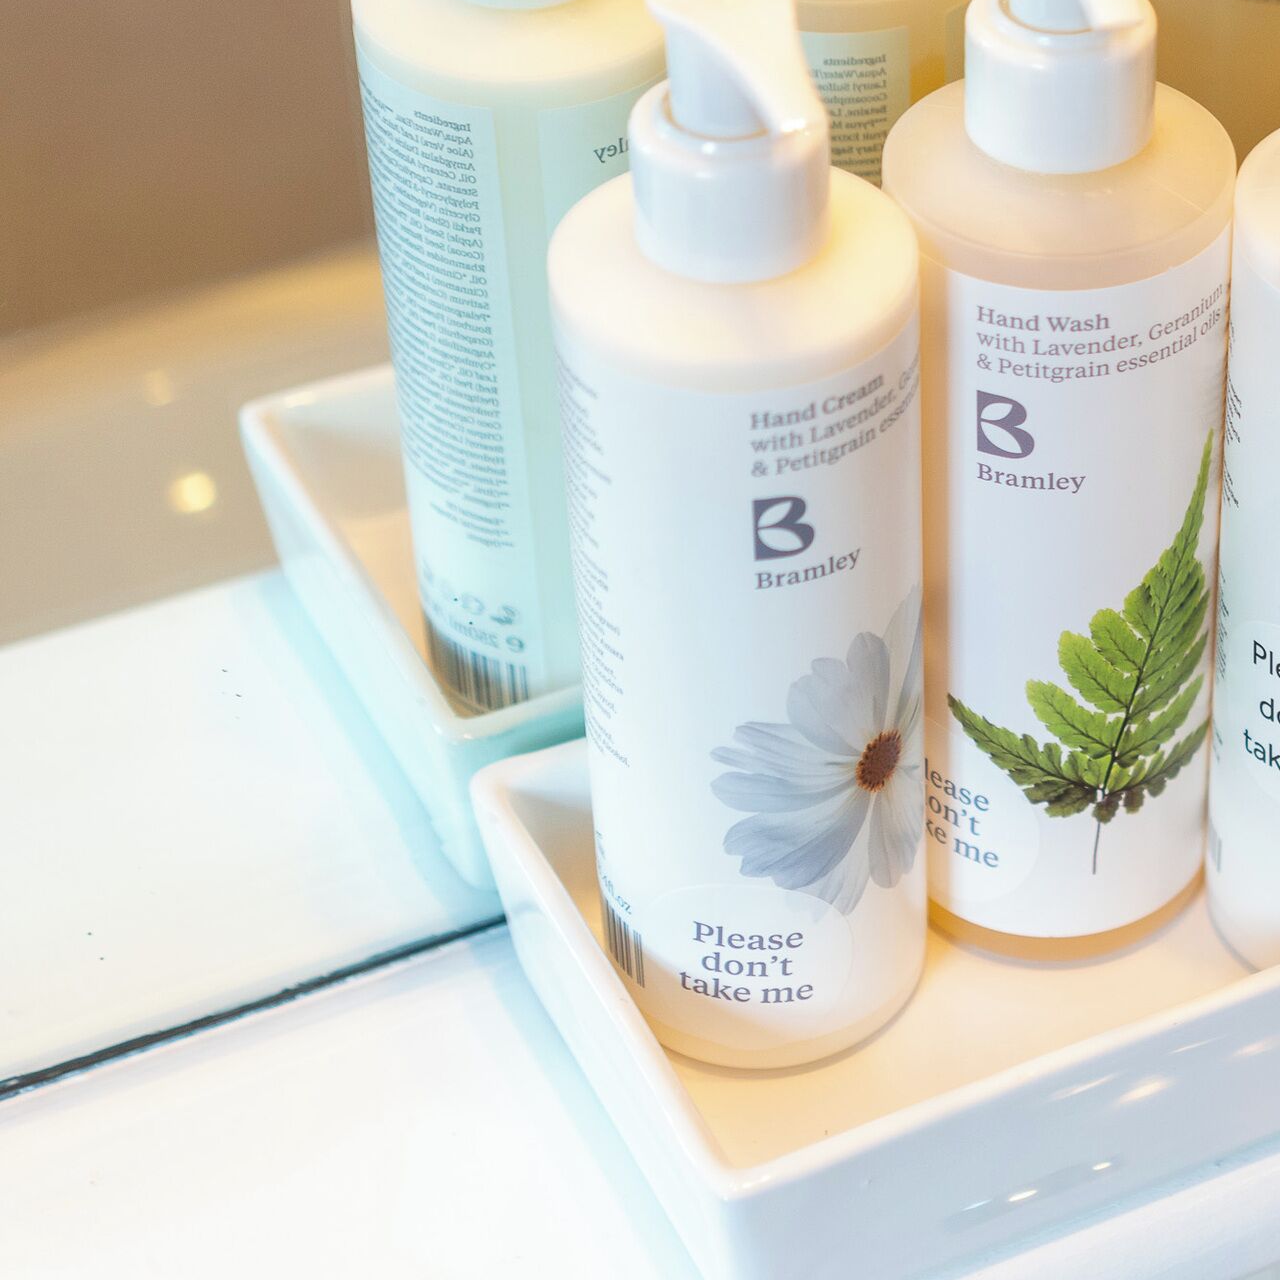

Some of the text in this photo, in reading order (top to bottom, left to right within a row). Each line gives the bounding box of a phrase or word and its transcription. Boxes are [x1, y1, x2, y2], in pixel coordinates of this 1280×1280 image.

[976, 304, 1110, 333] Hand Wash
[976, 282, 1223, 357] with Lavender, Geranium
[976, 306, 1221, 384] & Petitgrain essential oils
[750, 402, 815, 431] Hand
[822, 374, 884, 416] Cream
[750, 390, 897, 454] with Lavender,
[751, 459, 769, 477] &
[775, 426, 876, 476] Petitgrain
[976, 462, 1087, 494] Bramley
[754, 547, 861, 590] Bramley
[924, 757, 990, 812] lease
[928, 795, 982, 837] on't
[954, 837, 1000, 868] me
[692, 920, 804, 951] Please
[679, 971, 814, 1004] take me
